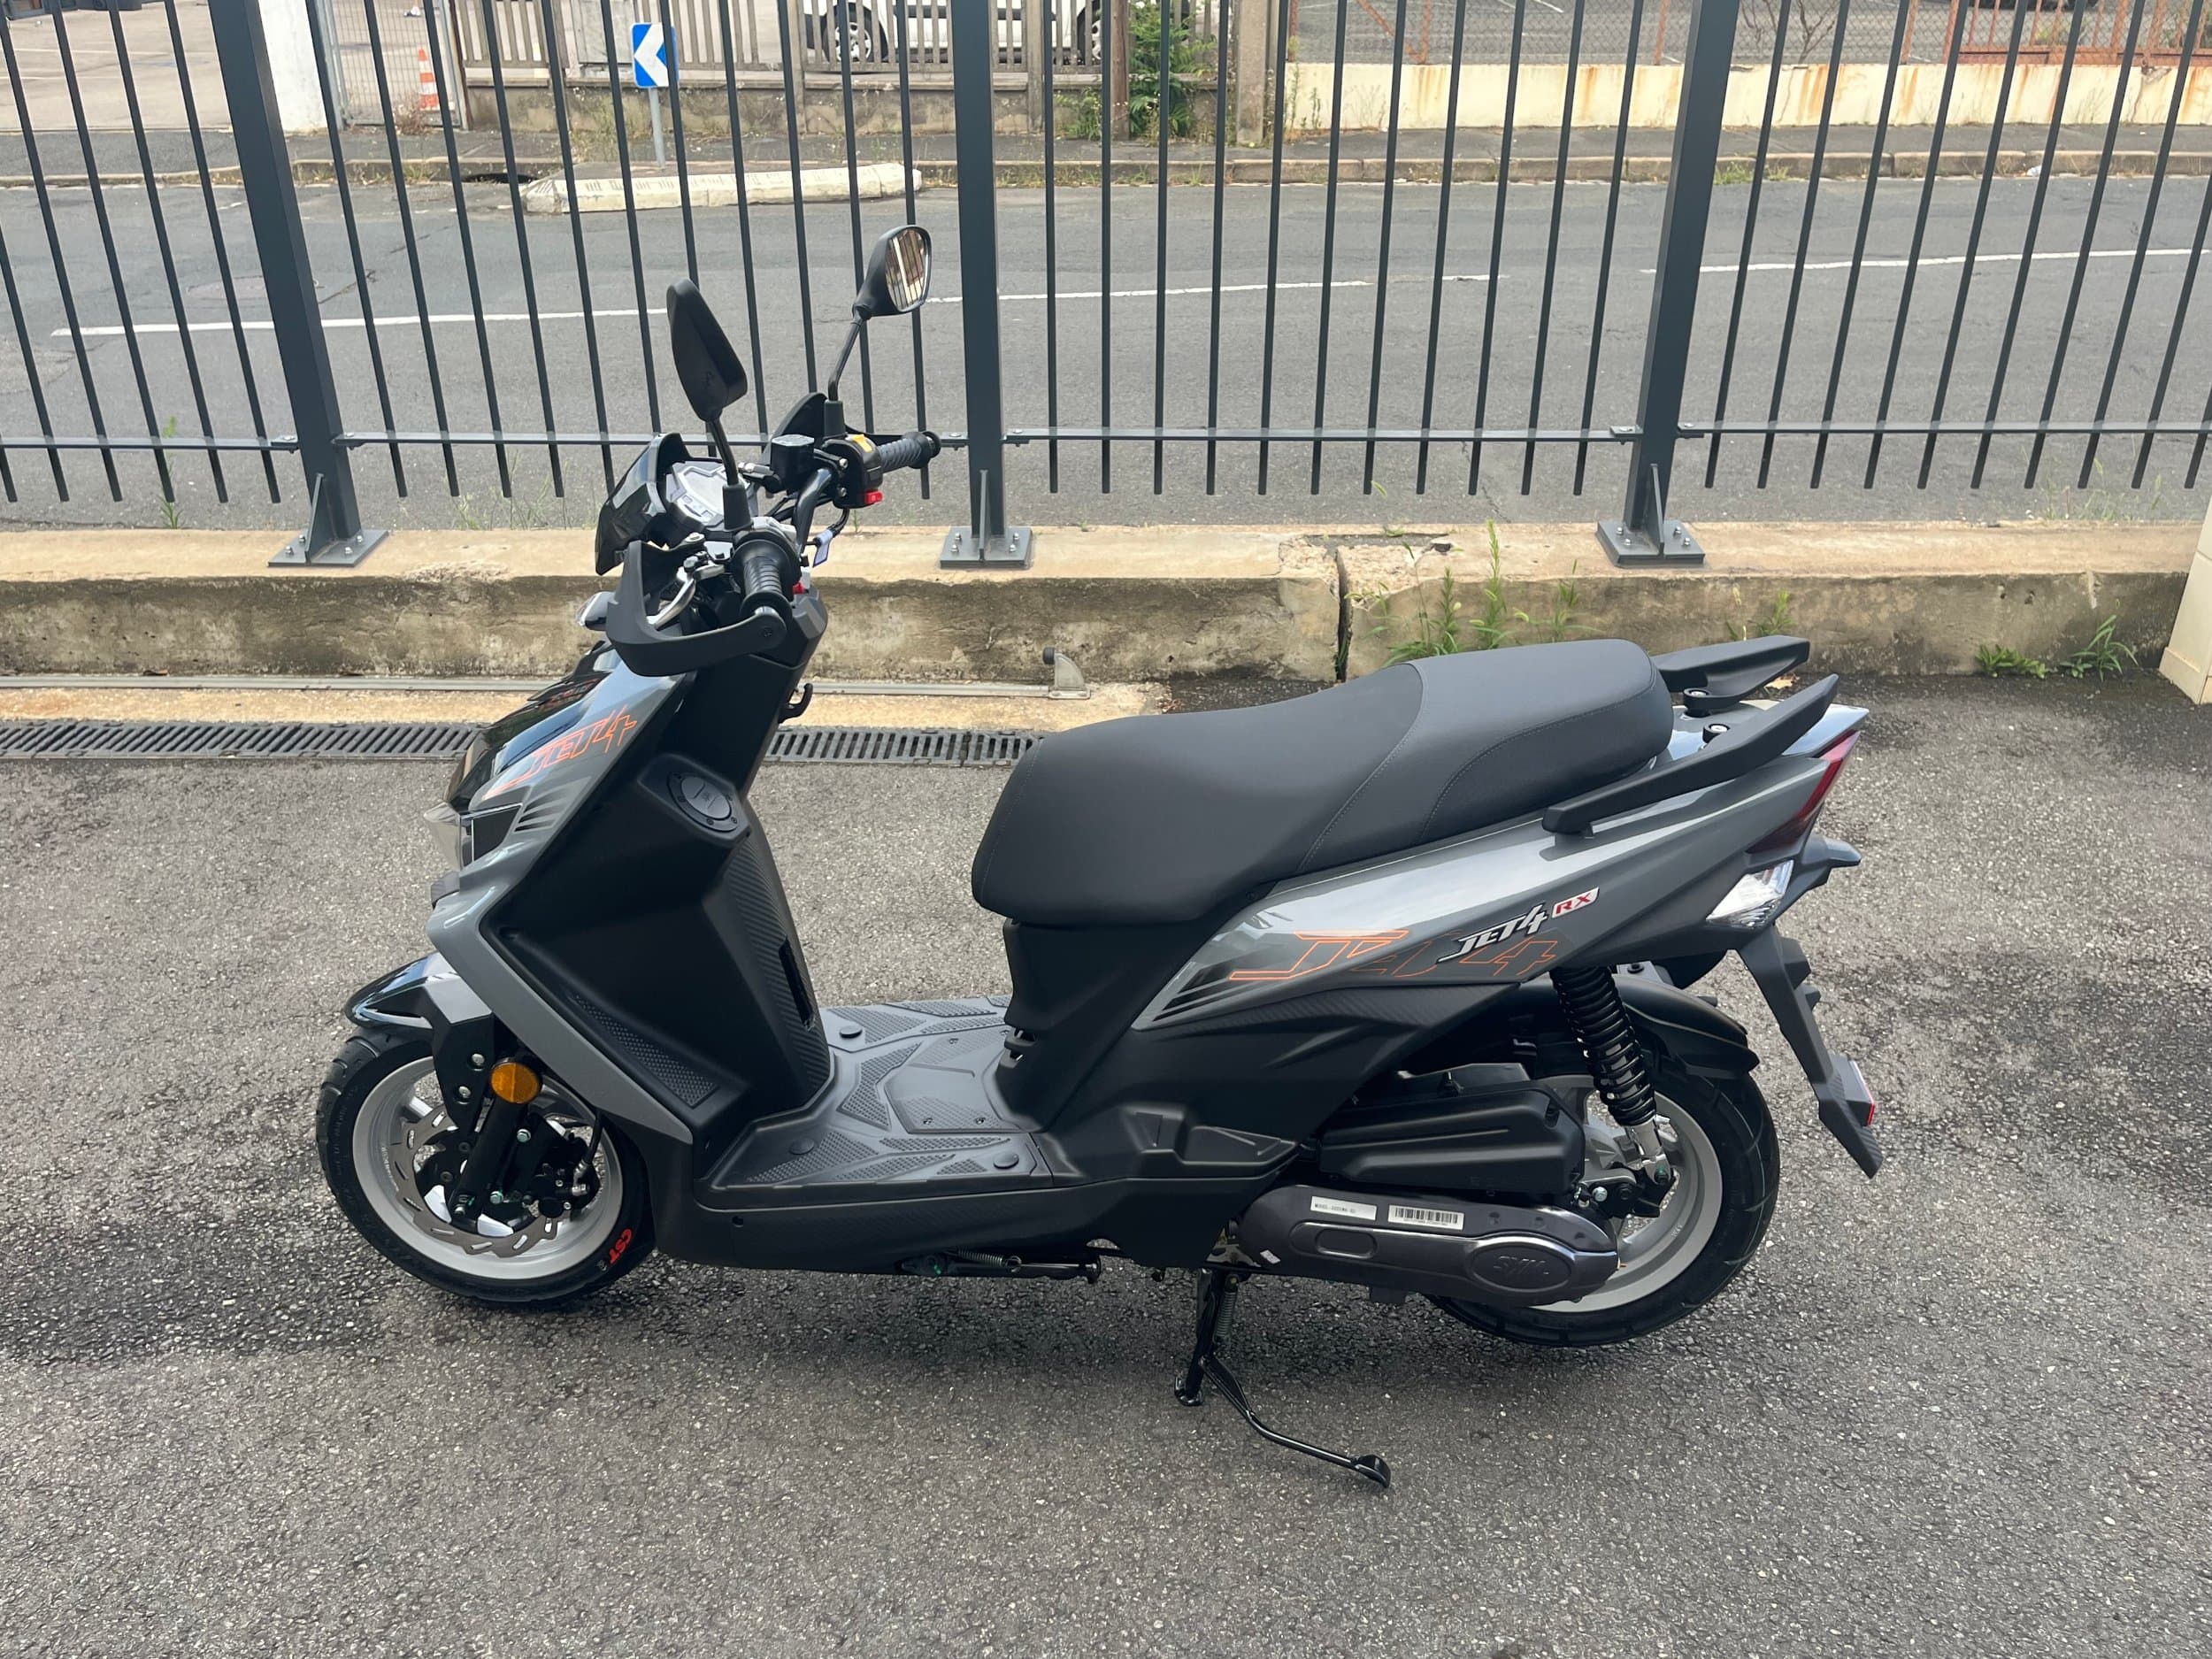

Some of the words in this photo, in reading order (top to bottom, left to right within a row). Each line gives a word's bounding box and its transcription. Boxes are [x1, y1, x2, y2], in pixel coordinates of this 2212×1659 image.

[481, 705, 637, 800] JET4
[1437, 903, 1548, 964] JET4
[1555, 893, 1591, 915] RX
[609, 1228, 633, 1264] CST
